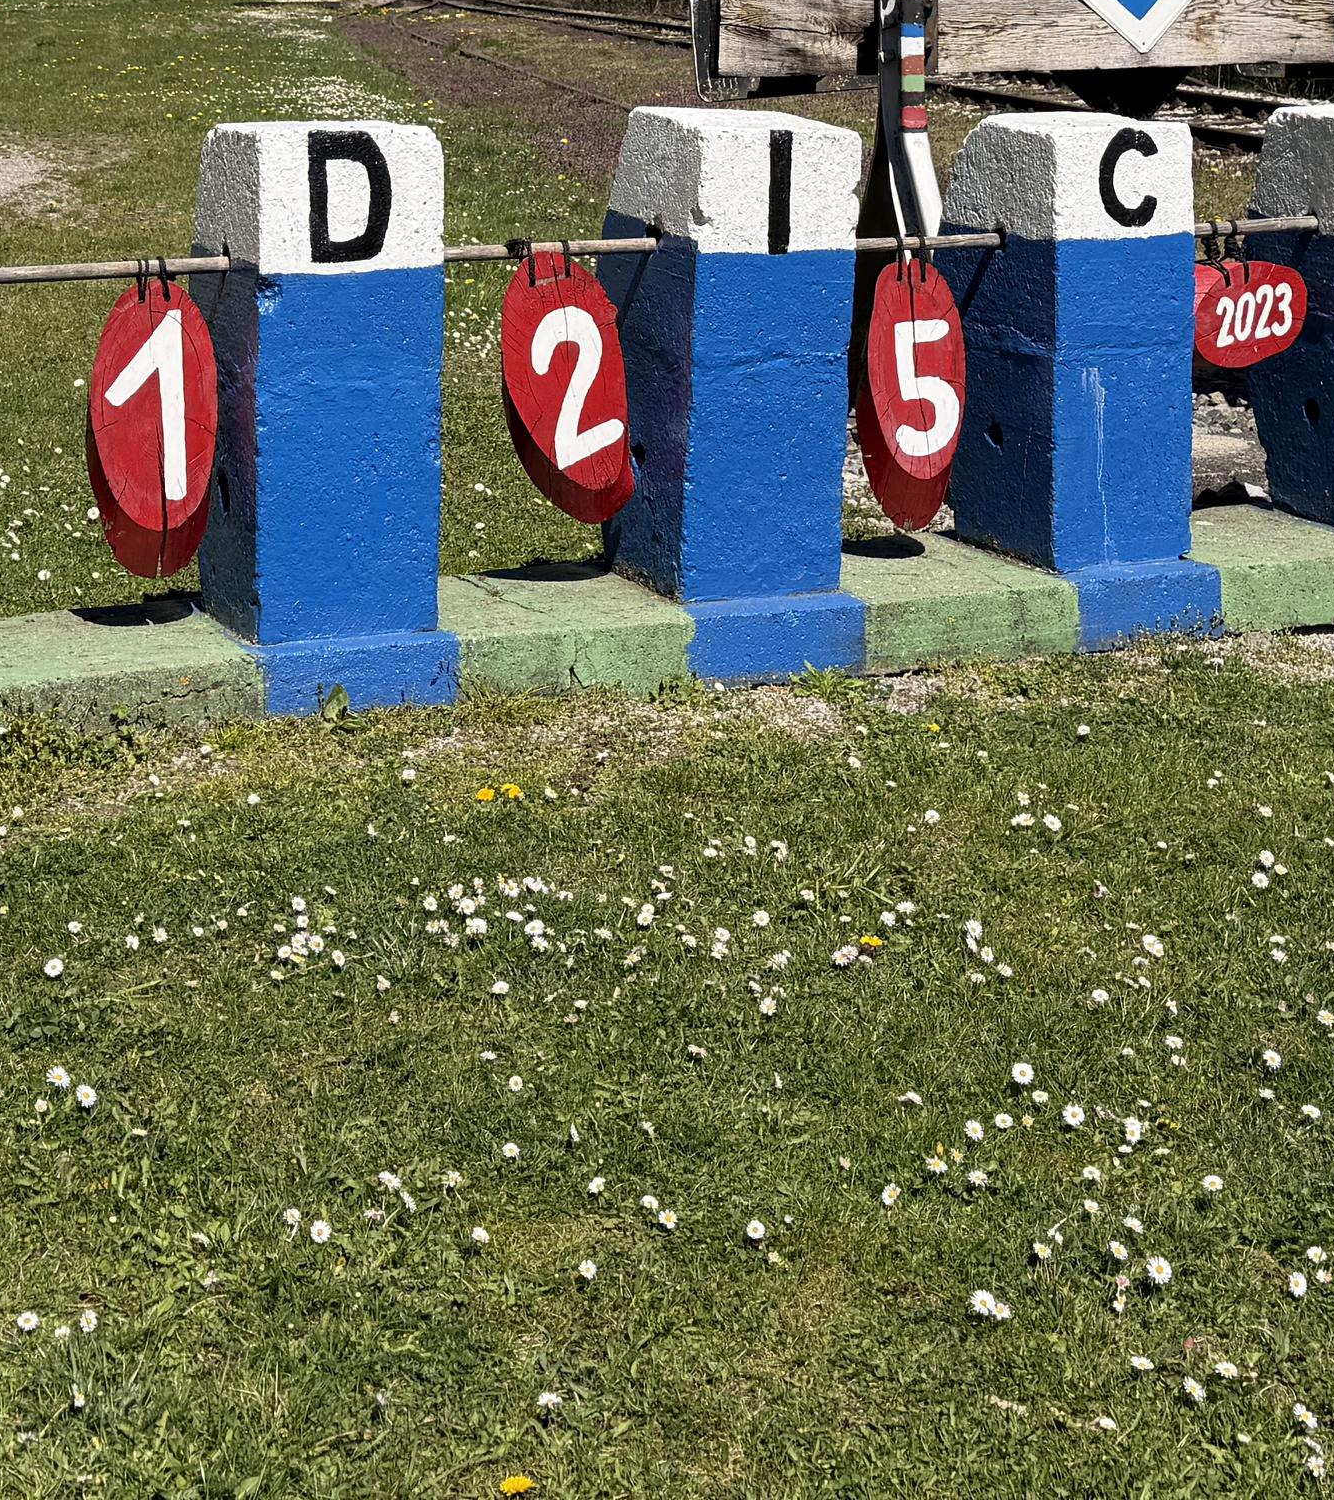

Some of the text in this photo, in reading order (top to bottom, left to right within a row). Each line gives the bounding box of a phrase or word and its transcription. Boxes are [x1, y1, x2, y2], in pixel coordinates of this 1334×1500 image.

[1215, 282, 1293, 348] 2023
[104, 305, 961, 501] 1 2 5
